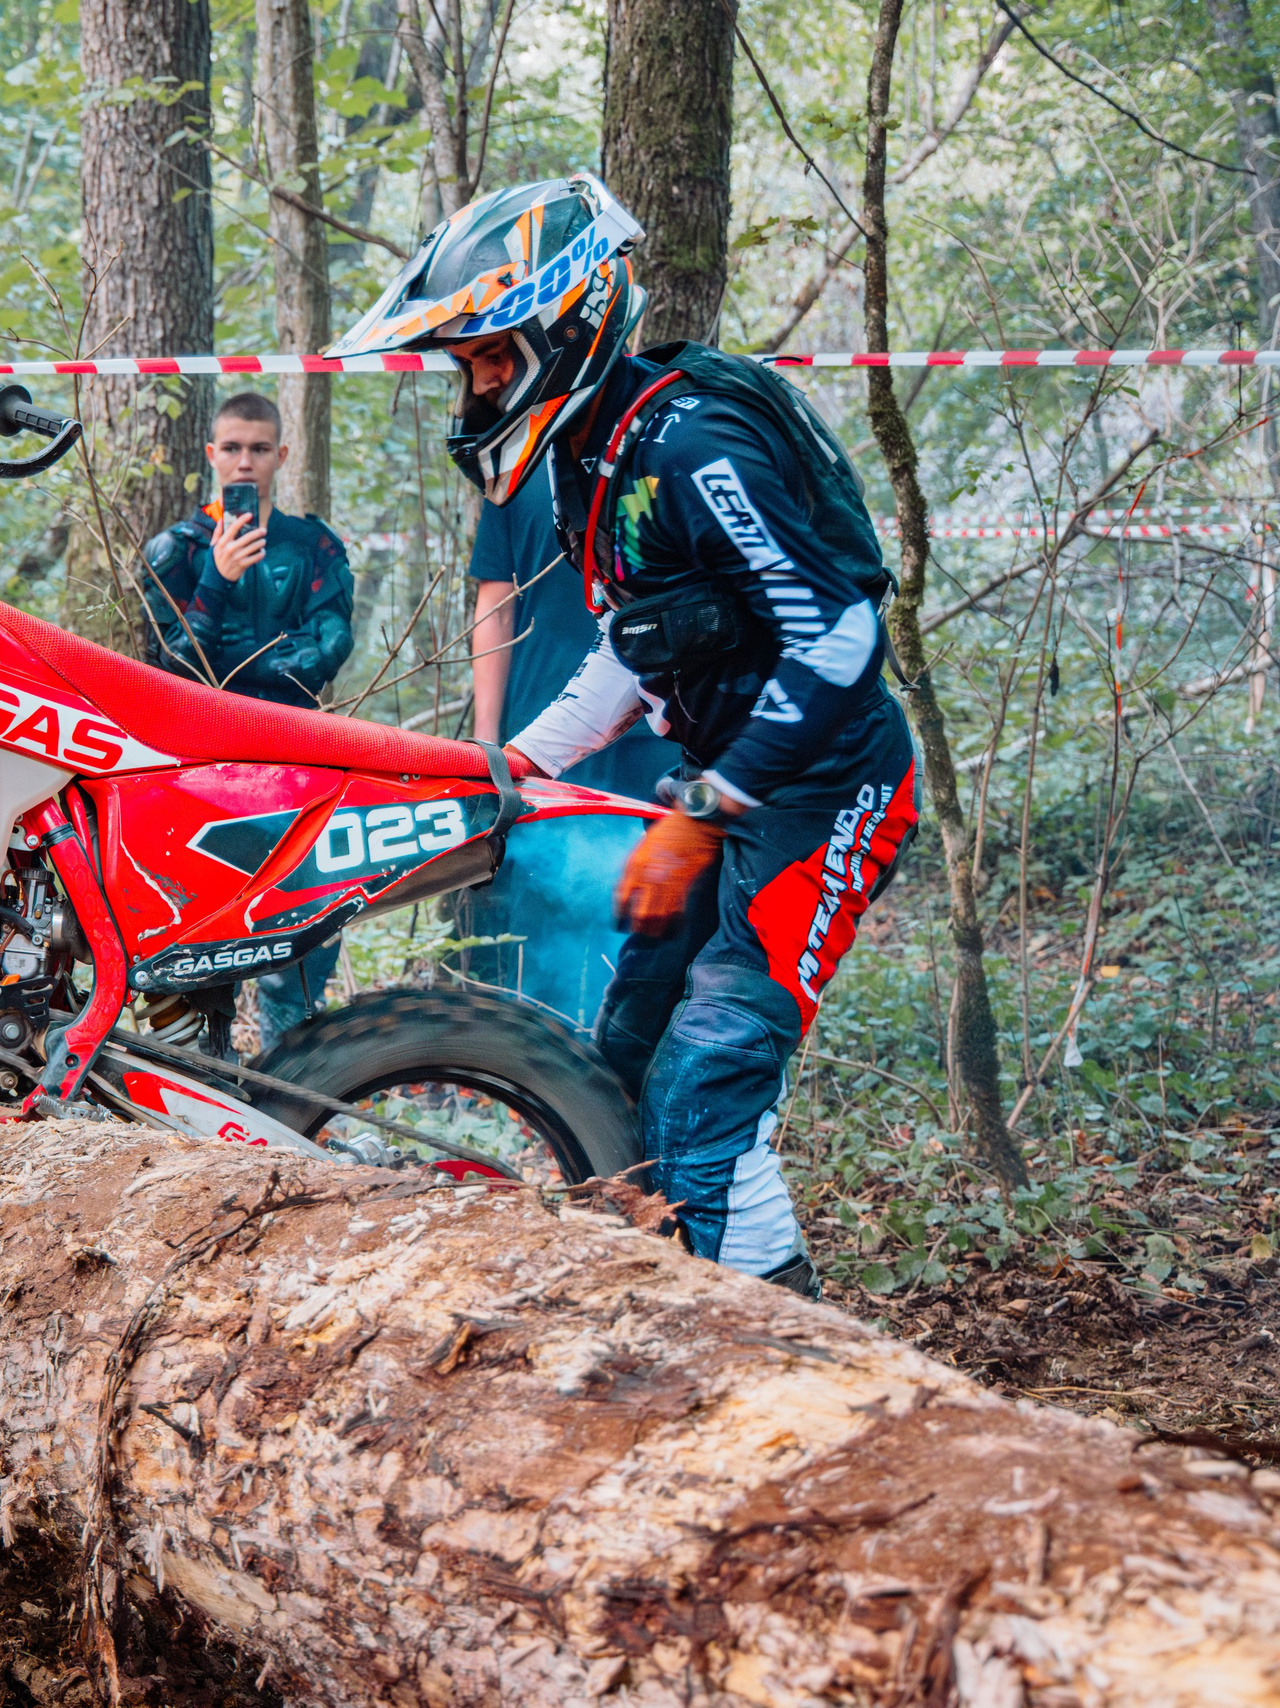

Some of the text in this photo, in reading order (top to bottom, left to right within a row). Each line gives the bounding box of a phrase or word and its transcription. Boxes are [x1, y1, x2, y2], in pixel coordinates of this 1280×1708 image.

[460, 226, 609, 334] 100%
[315, 799, 466, 873] 023
[173, 941, 293, 976] GASGAS
